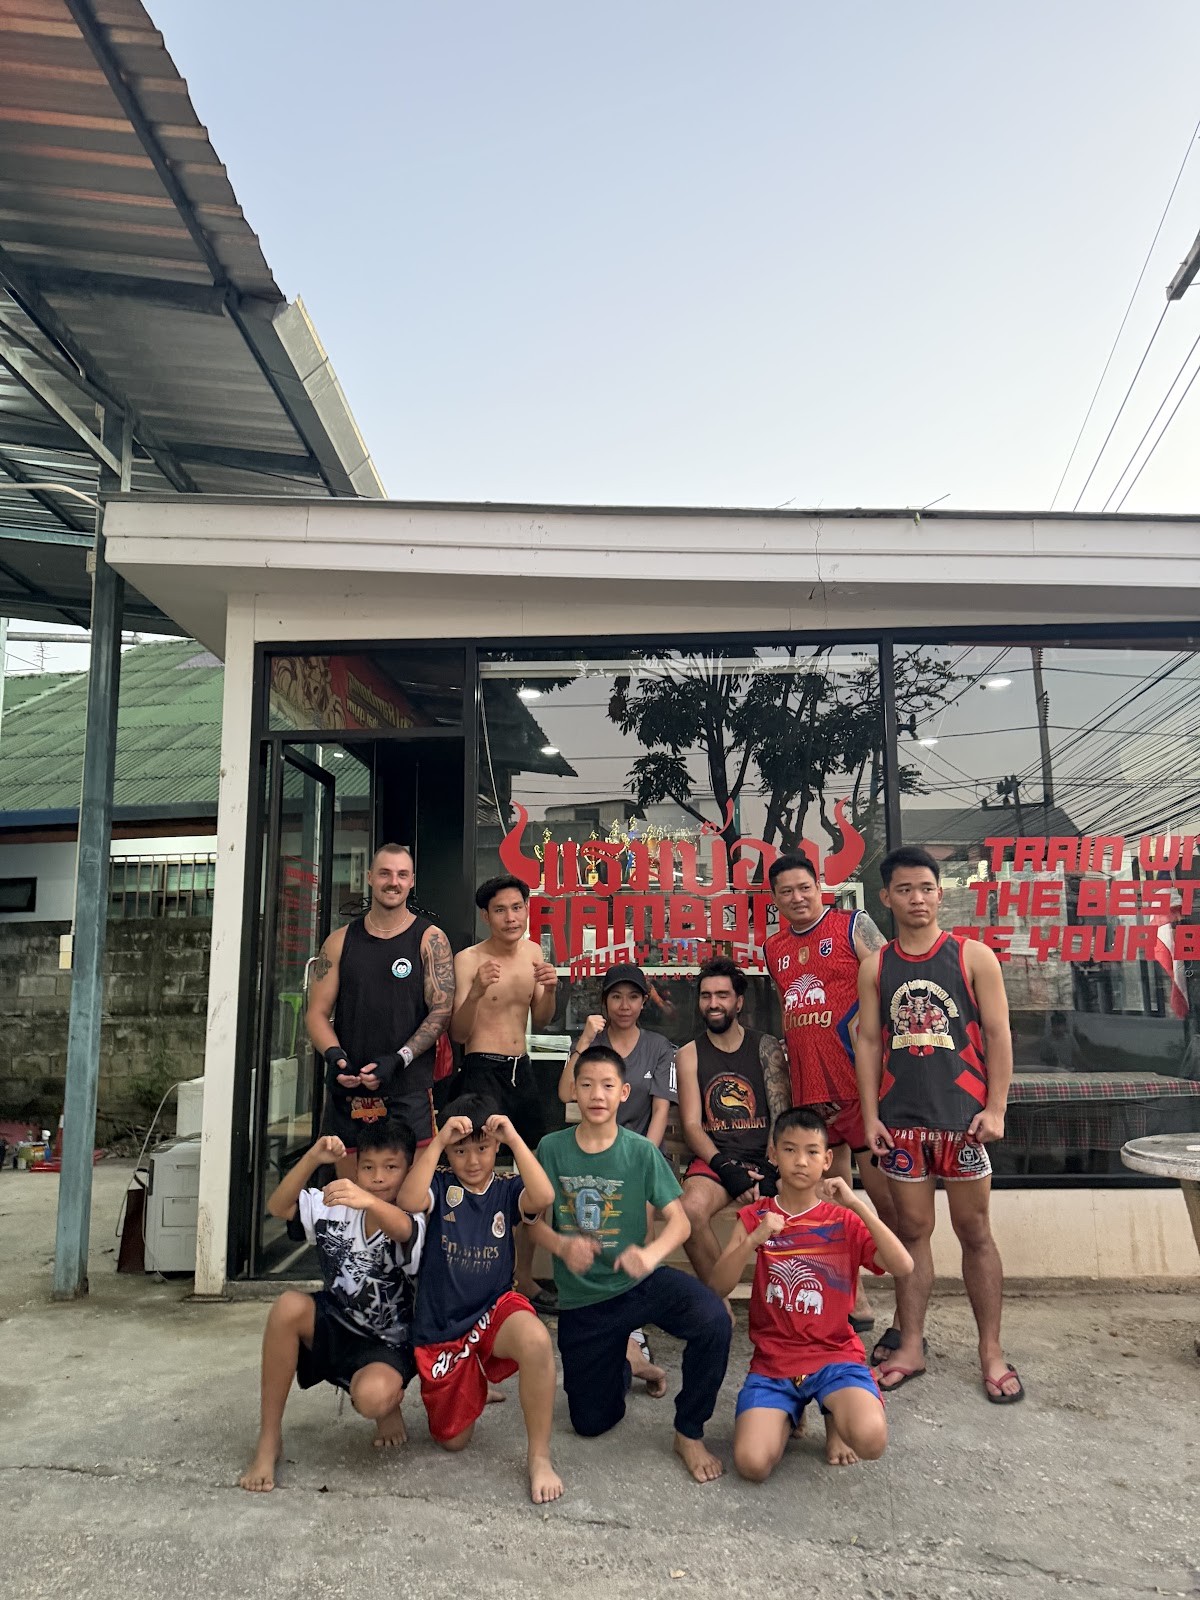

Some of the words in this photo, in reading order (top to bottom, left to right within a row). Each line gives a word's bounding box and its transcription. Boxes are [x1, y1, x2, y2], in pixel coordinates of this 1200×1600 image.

[984, 836, 1124, 872] TRAIN
[1139, 835, 1200, 872] WI
[970, 880, 1063, 917] THE
[1076, 879, 1200, 916] BEST
[529, 893, 836, 964] RAMBON
[1029, 925, 1159, 962] YOUR
[570, 944, 649, 984] MUAY
[658, 943, 723, 964] THAI
[777, 955, 791, 972] 18
[784, 1010, 833, 1031] Chang
[732, 1116, 767, 1130] KOMBAT
[894, 1129, 914, 1140] PRO
[920, 1131, 963, 1142] BOXING
